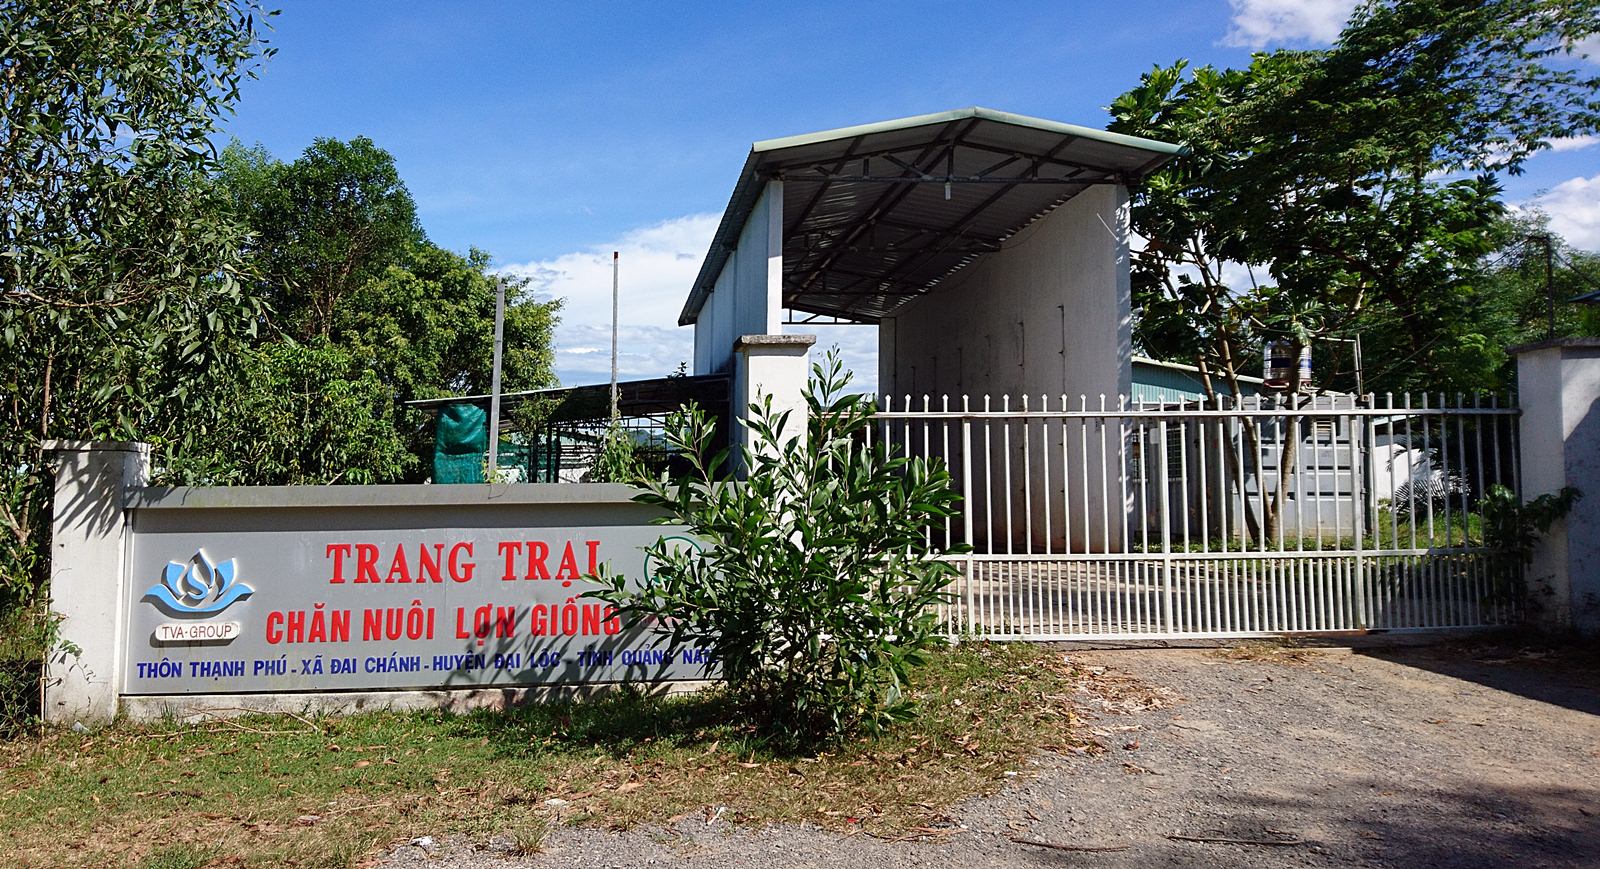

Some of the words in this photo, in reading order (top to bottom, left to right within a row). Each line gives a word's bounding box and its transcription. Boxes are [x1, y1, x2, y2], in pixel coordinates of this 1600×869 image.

[326, 542, 476, 583] TRANG
[498, 541, 601, 587] TRẠI
[162, 625, 232, 639] TVA-GROUP
[266, 602, 351, 645] CHĂN
[363, 599, 435, 642] NUÔI
[456, 603, 515, 646] LỢN
[137, 657, 182, 678] THÔN
[189, 661, 245, 681] THẠNH
[254, 654, 287, 676] PHÚ
[301, 654, 323, 674] XÃ
[365, 652, 421, 673] CHÁNH
[433, 650, 486, 674] HUYỆN
[494, 653, 521, 672] ĐẠI
